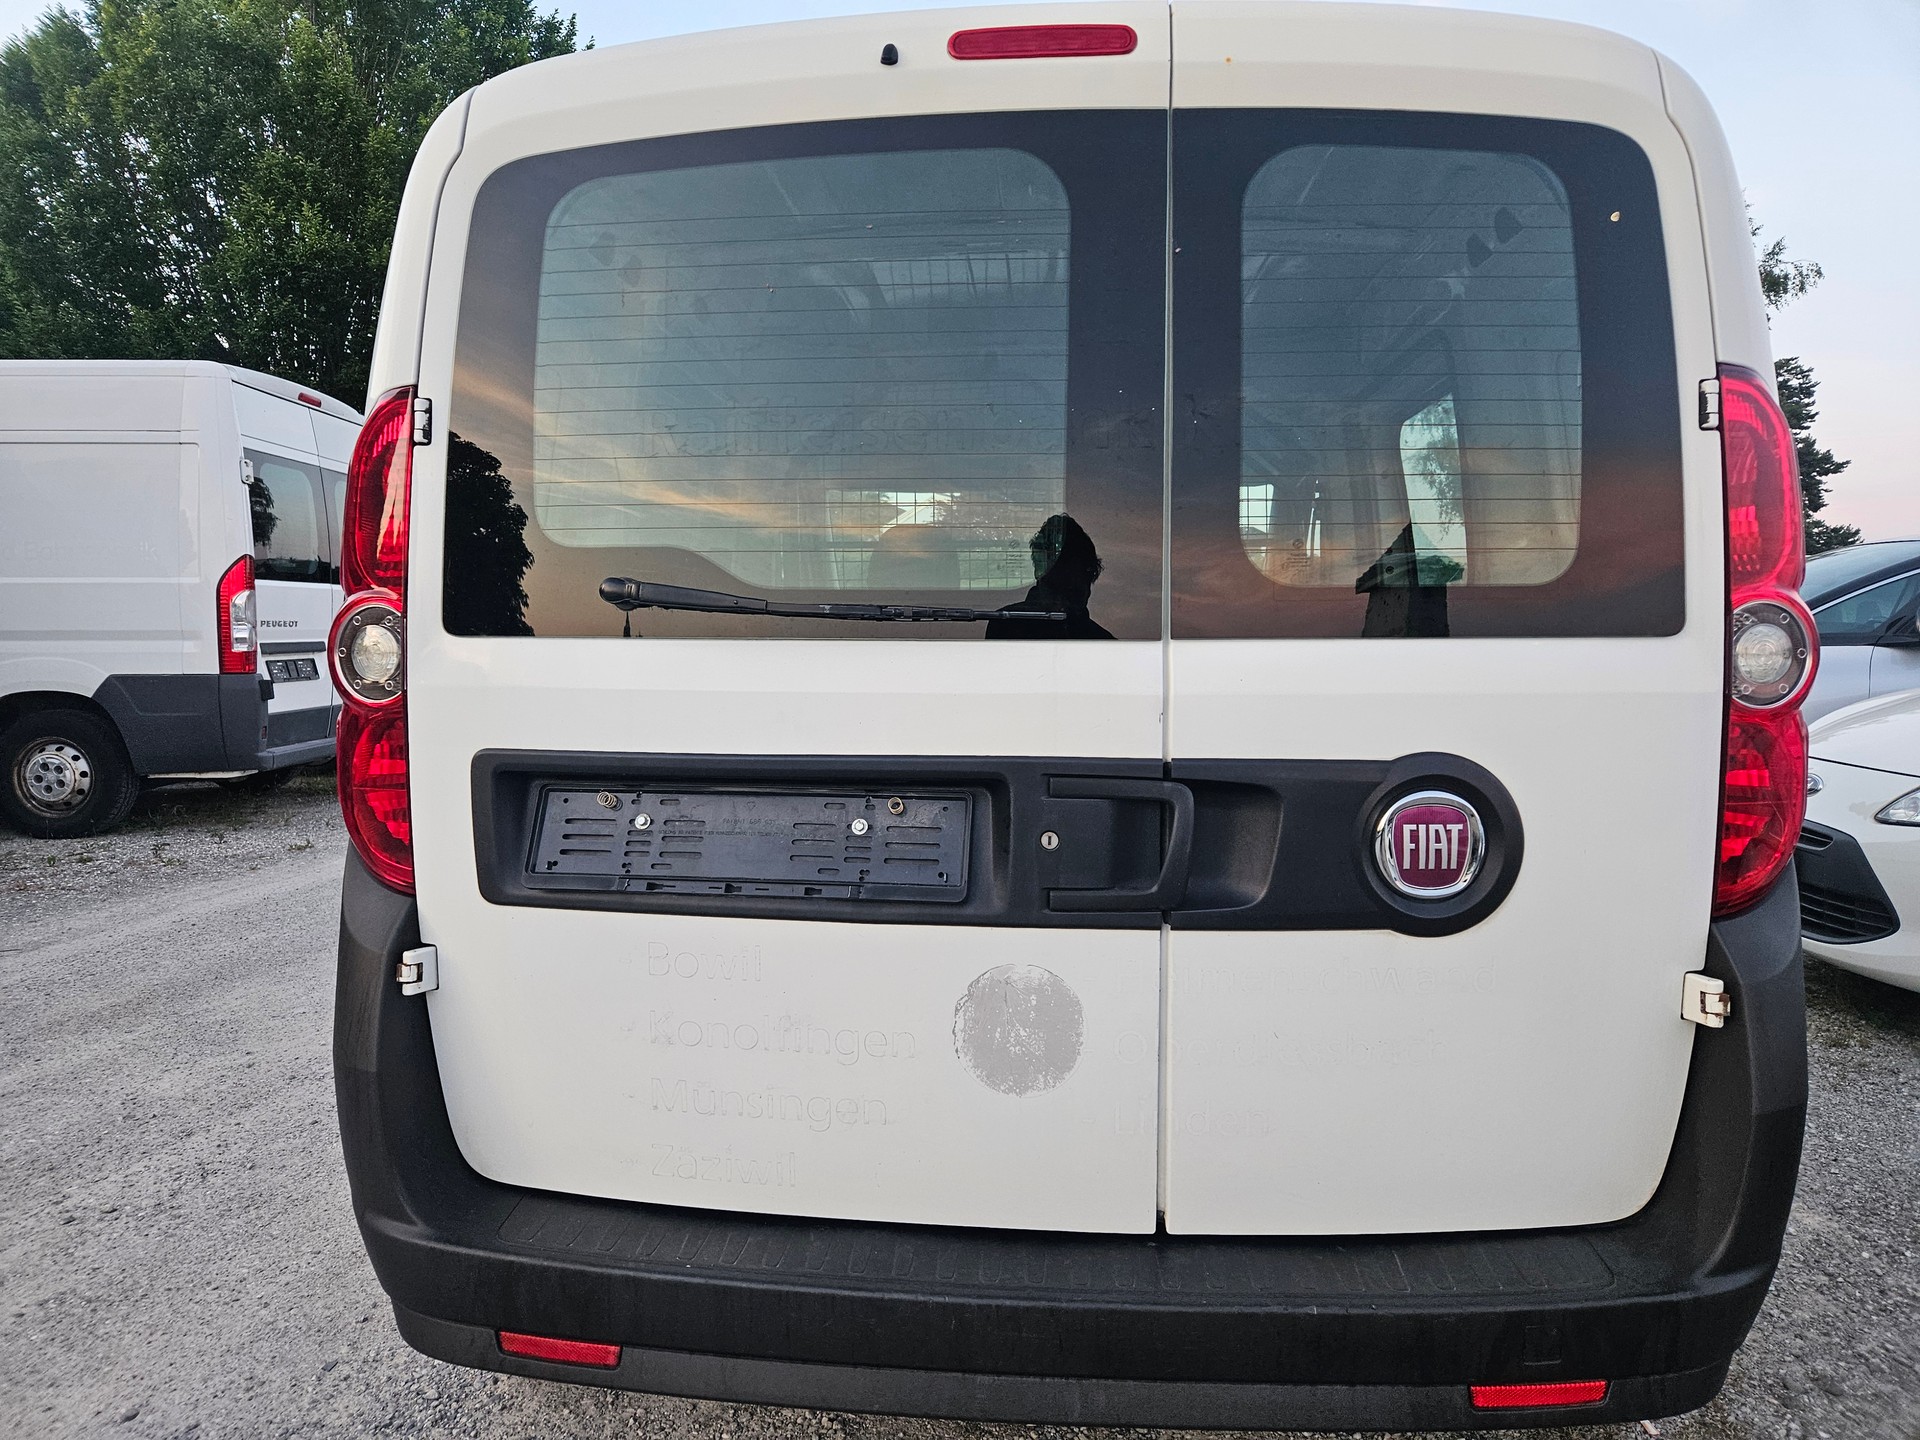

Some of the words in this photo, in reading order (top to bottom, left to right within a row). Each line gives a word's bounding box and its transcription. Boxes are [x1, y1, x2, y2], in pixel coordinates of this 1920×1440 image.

[1402, 823, 1464, 870] FIAT
[648, 941, 761, 981] Bowil
[649, 1010, 916, 1066] Konolfingen
[651, 1077, 888, 1132] Münsingen
